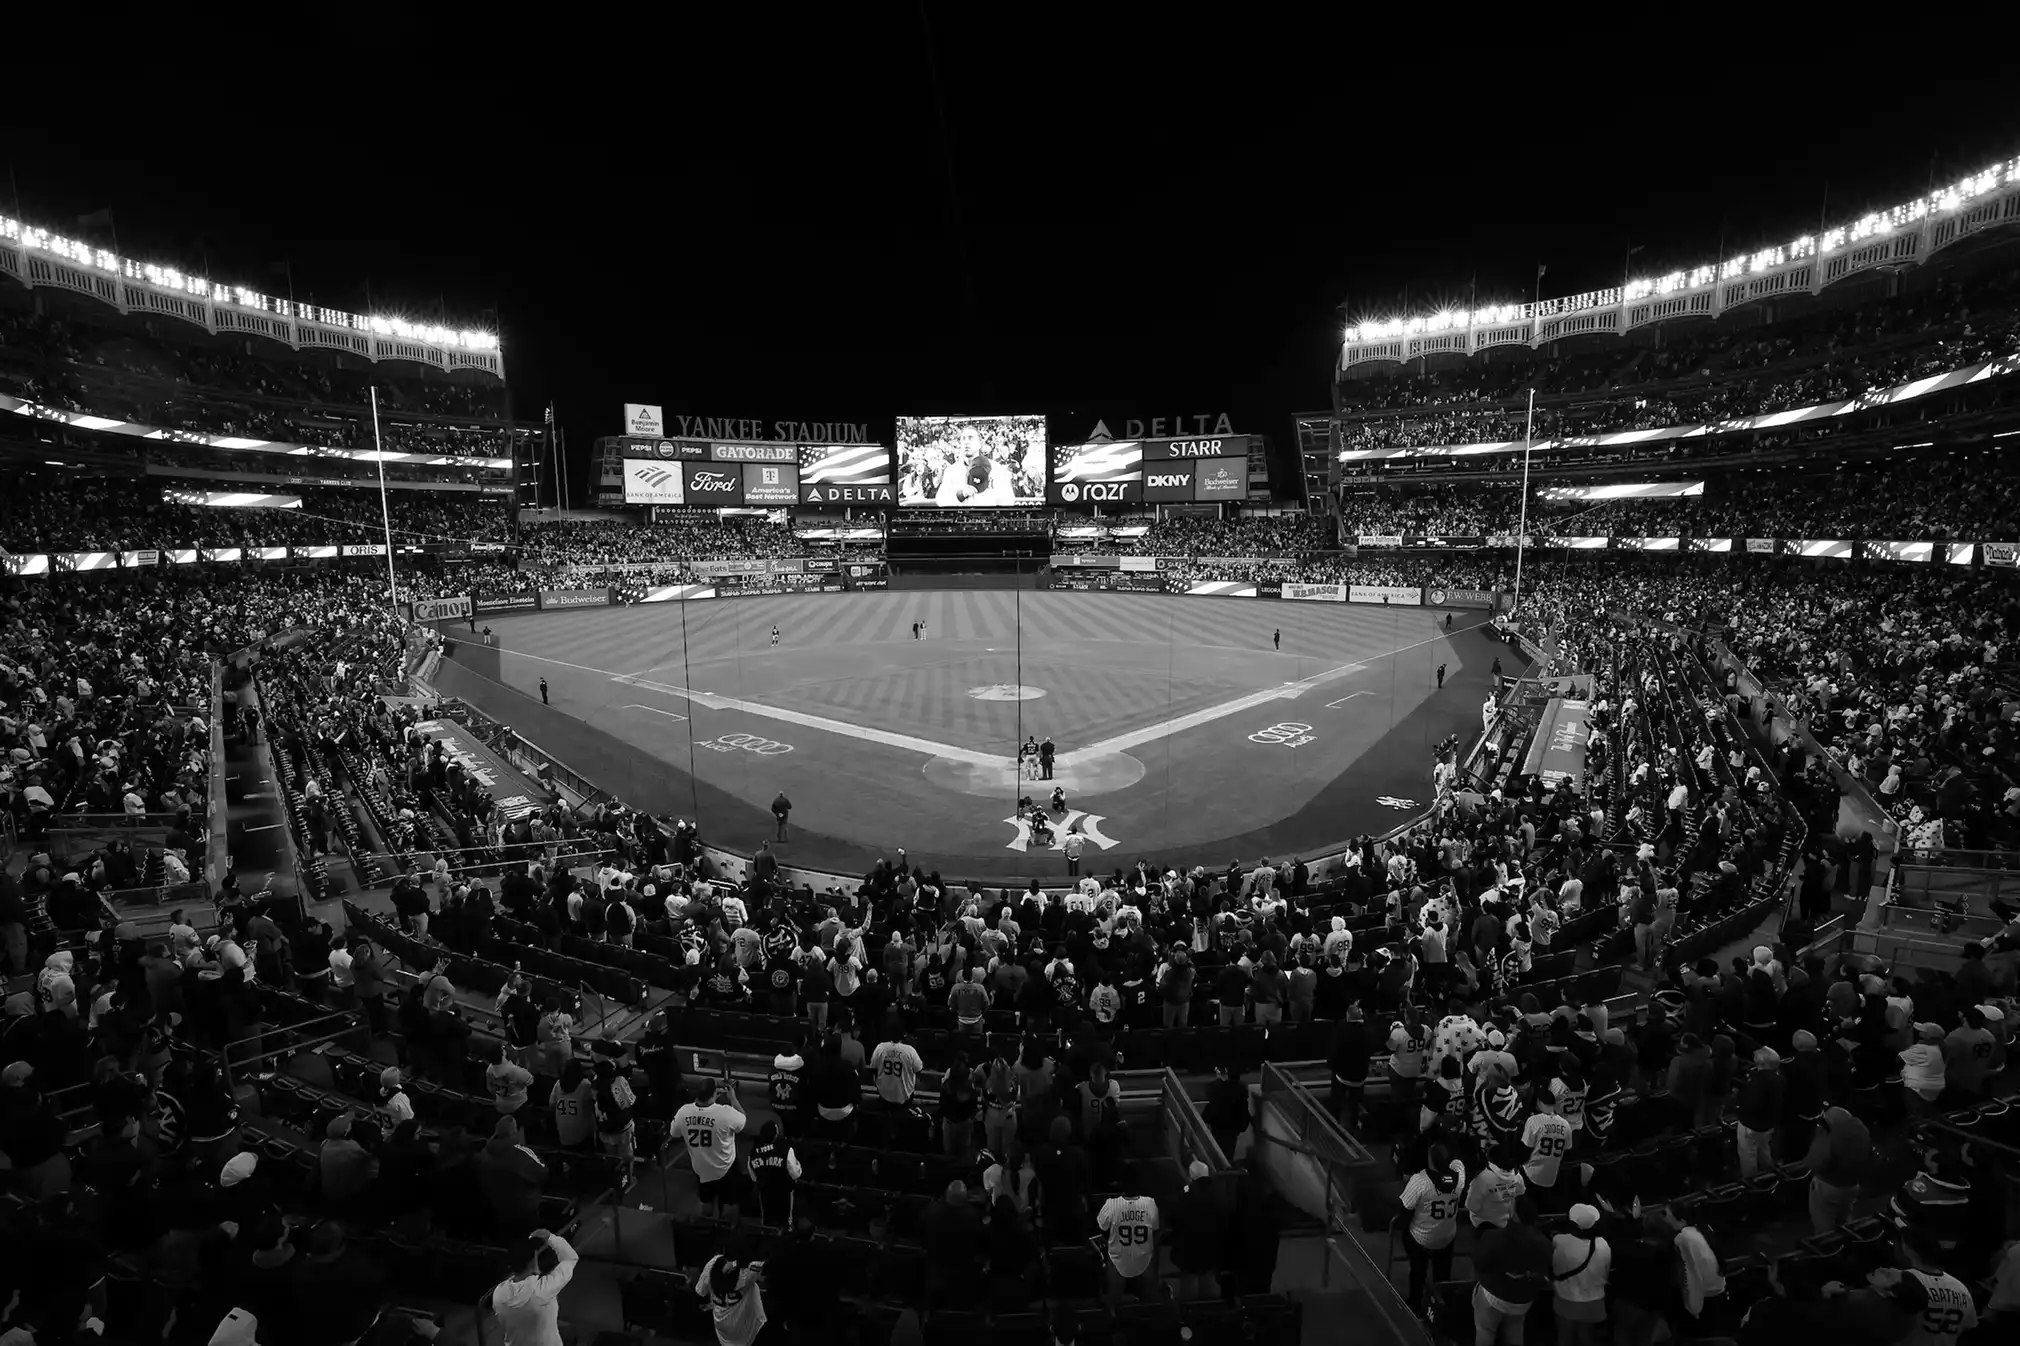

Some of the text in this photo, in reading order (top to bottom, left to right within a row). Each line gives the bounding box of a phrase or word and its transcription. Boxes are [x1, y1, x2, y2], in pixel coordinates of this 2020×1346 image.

[631, 419, 659, 428] Benjamin
[675, 415, 868, 443] YANKEE STADIUM
[1126, 412, 1233, 438] DELTA
[630, 444, 652, 452] PEPSI
[716, 446, 794, 460] GATORADE
[1169, 440, 1222, 457] STARR
[690, 472, 736, 492] Ford
[1147, 473, 1191, 487] DKNY
[829, 488, 891, 501] DELTA
[1083, 483, 1128, 500] razr
[350, 545, 378, 556] ORIS
[560, 592, 607, 605] Budweiser
[1465, 593, 1493, 602] WEBB
[415, 600, 471, 619] Canon
[1137, 990, 1146, 1004] 2
[1407, 1038, 1426, 1053] 99
[883, 1060, 903, 1077] 99
[556, 1099, 578, 1116] 45
[1445, 1100, 1466, 1116] 99
[1563, 1096, 1584, 1114] 27
[685, 1115, 716, 1128] STOWERS
[1543, 1124, 1565, 1137] JUDGE
[688, 1129, 712, 1148] 28
[1538, 1137, 1566, 1158] 99
[751, 1156, 784, 1169] NEW YORK
[1120, 1210, 1145, 1223] JUDGE
[1118, 1225, 1147, 1246] 99
[1922, 1307, 1964, 1334] 52
